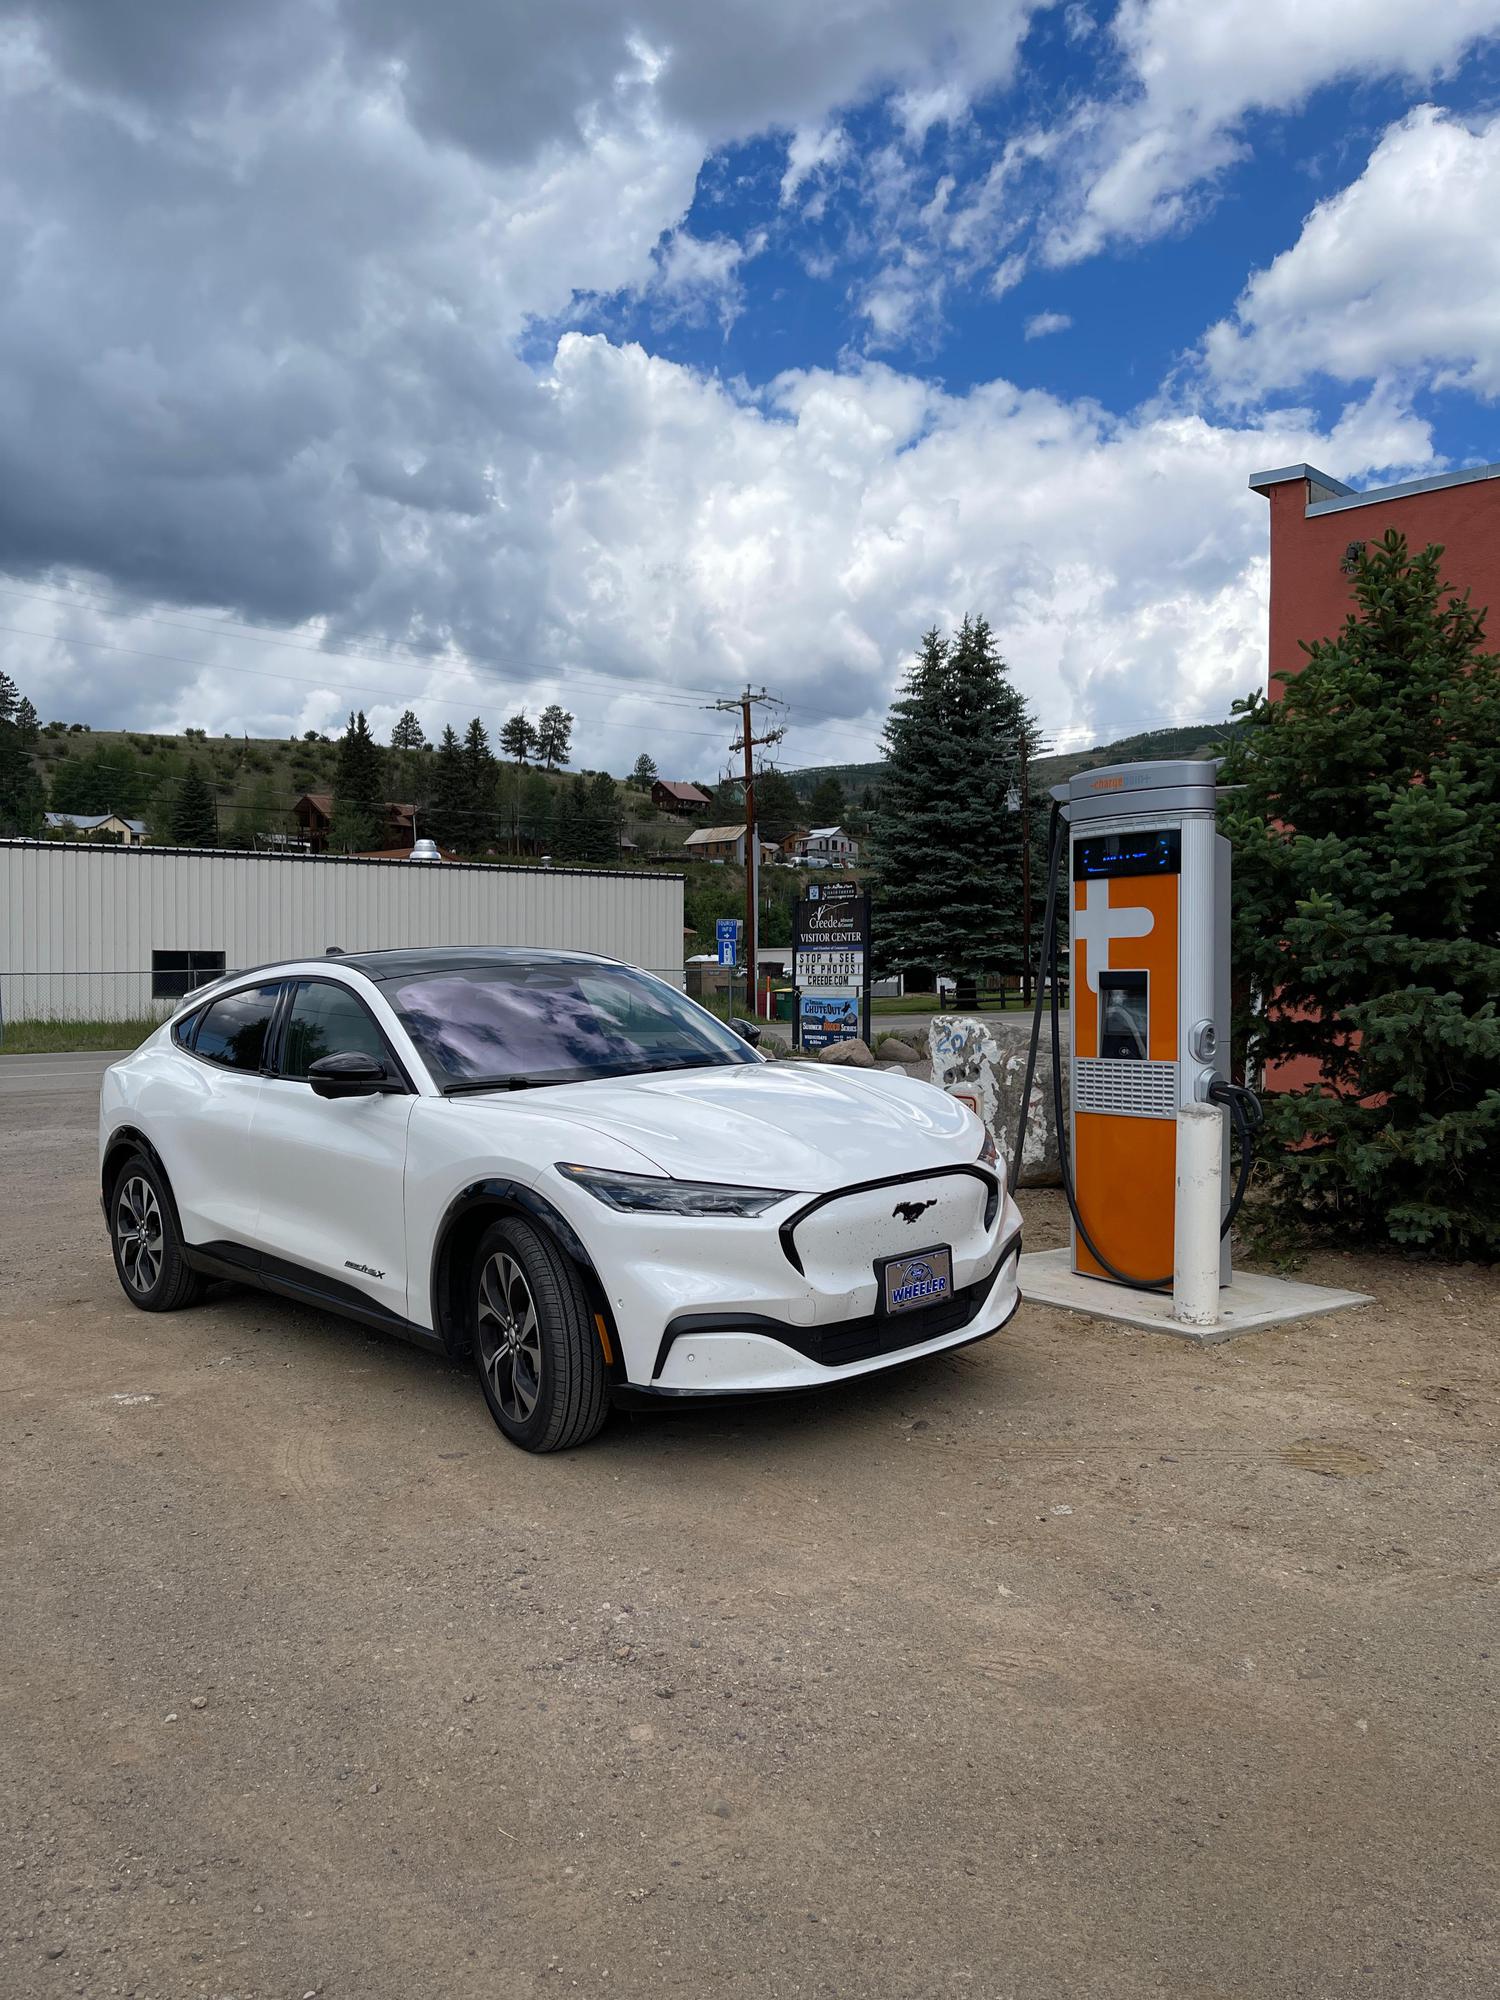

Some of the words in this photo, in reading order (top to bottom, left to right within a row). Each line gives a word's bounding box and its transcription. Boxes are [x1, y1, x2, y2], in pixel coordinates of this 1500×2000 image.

[809, 915, 838, 929] Creede
[800, 933, 830, 942] VISITOR
[831, 932, 862, 942] CENTER
[800, 953, 822, 963] STOP
[840, 953, 855, 963] SEE
[799, 965, 816, 974] THE
[821, 964, 860, 974] PHOTOS!
[892, 1277, 945, 1303] WHEELER
